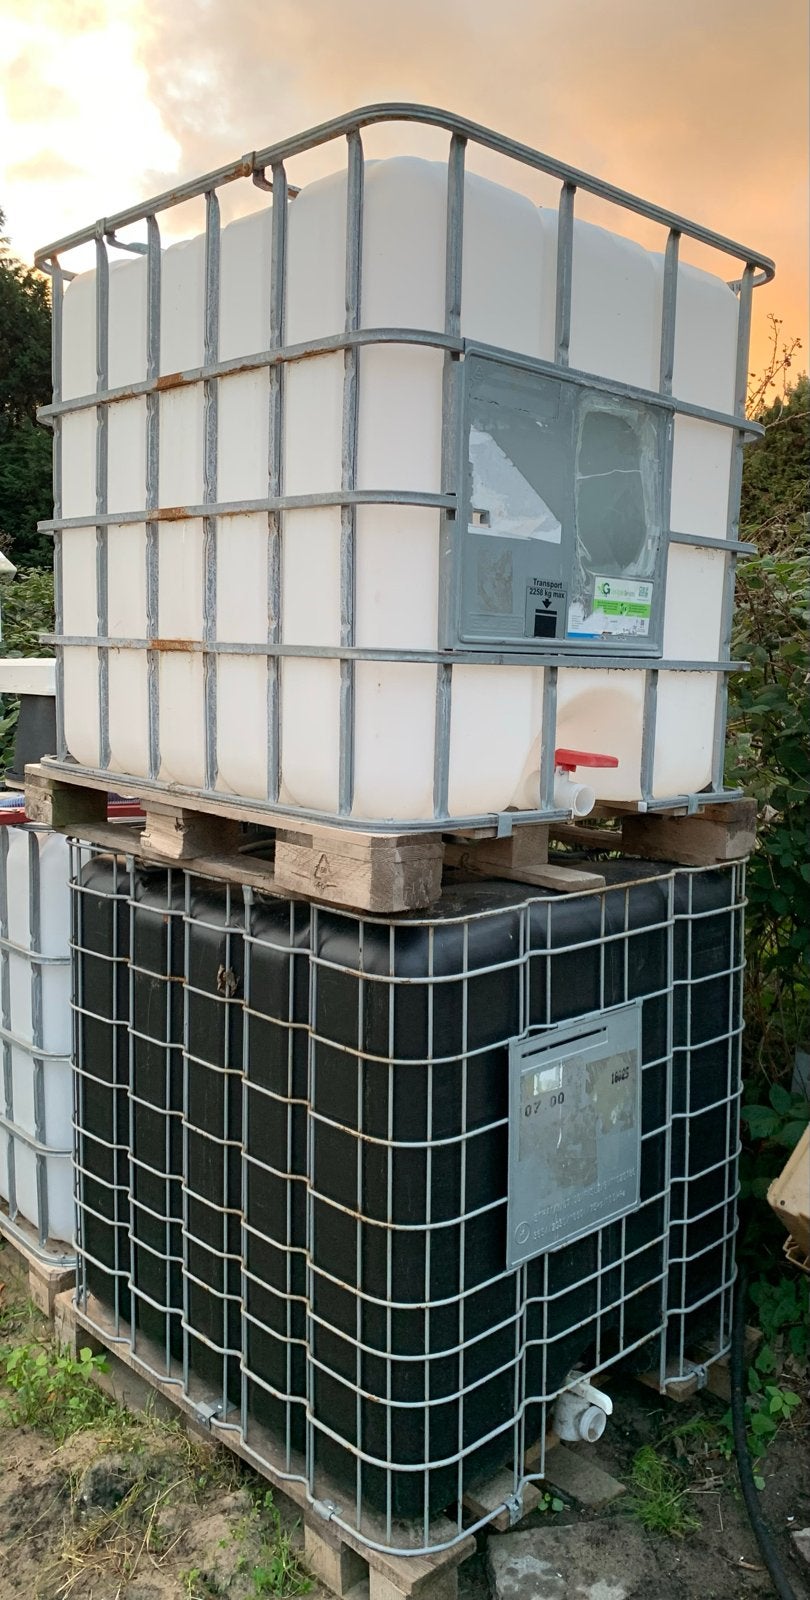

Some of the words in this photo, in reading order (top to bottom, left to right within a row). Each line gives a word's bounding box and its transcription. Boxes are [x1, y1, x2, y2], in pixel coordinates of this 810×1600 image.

[533, 578, 563, 589] Transport
[529, 587, 544, 597] 2258
[544, 590, 552, 599] kg
[552, 591, 565, 599] max
